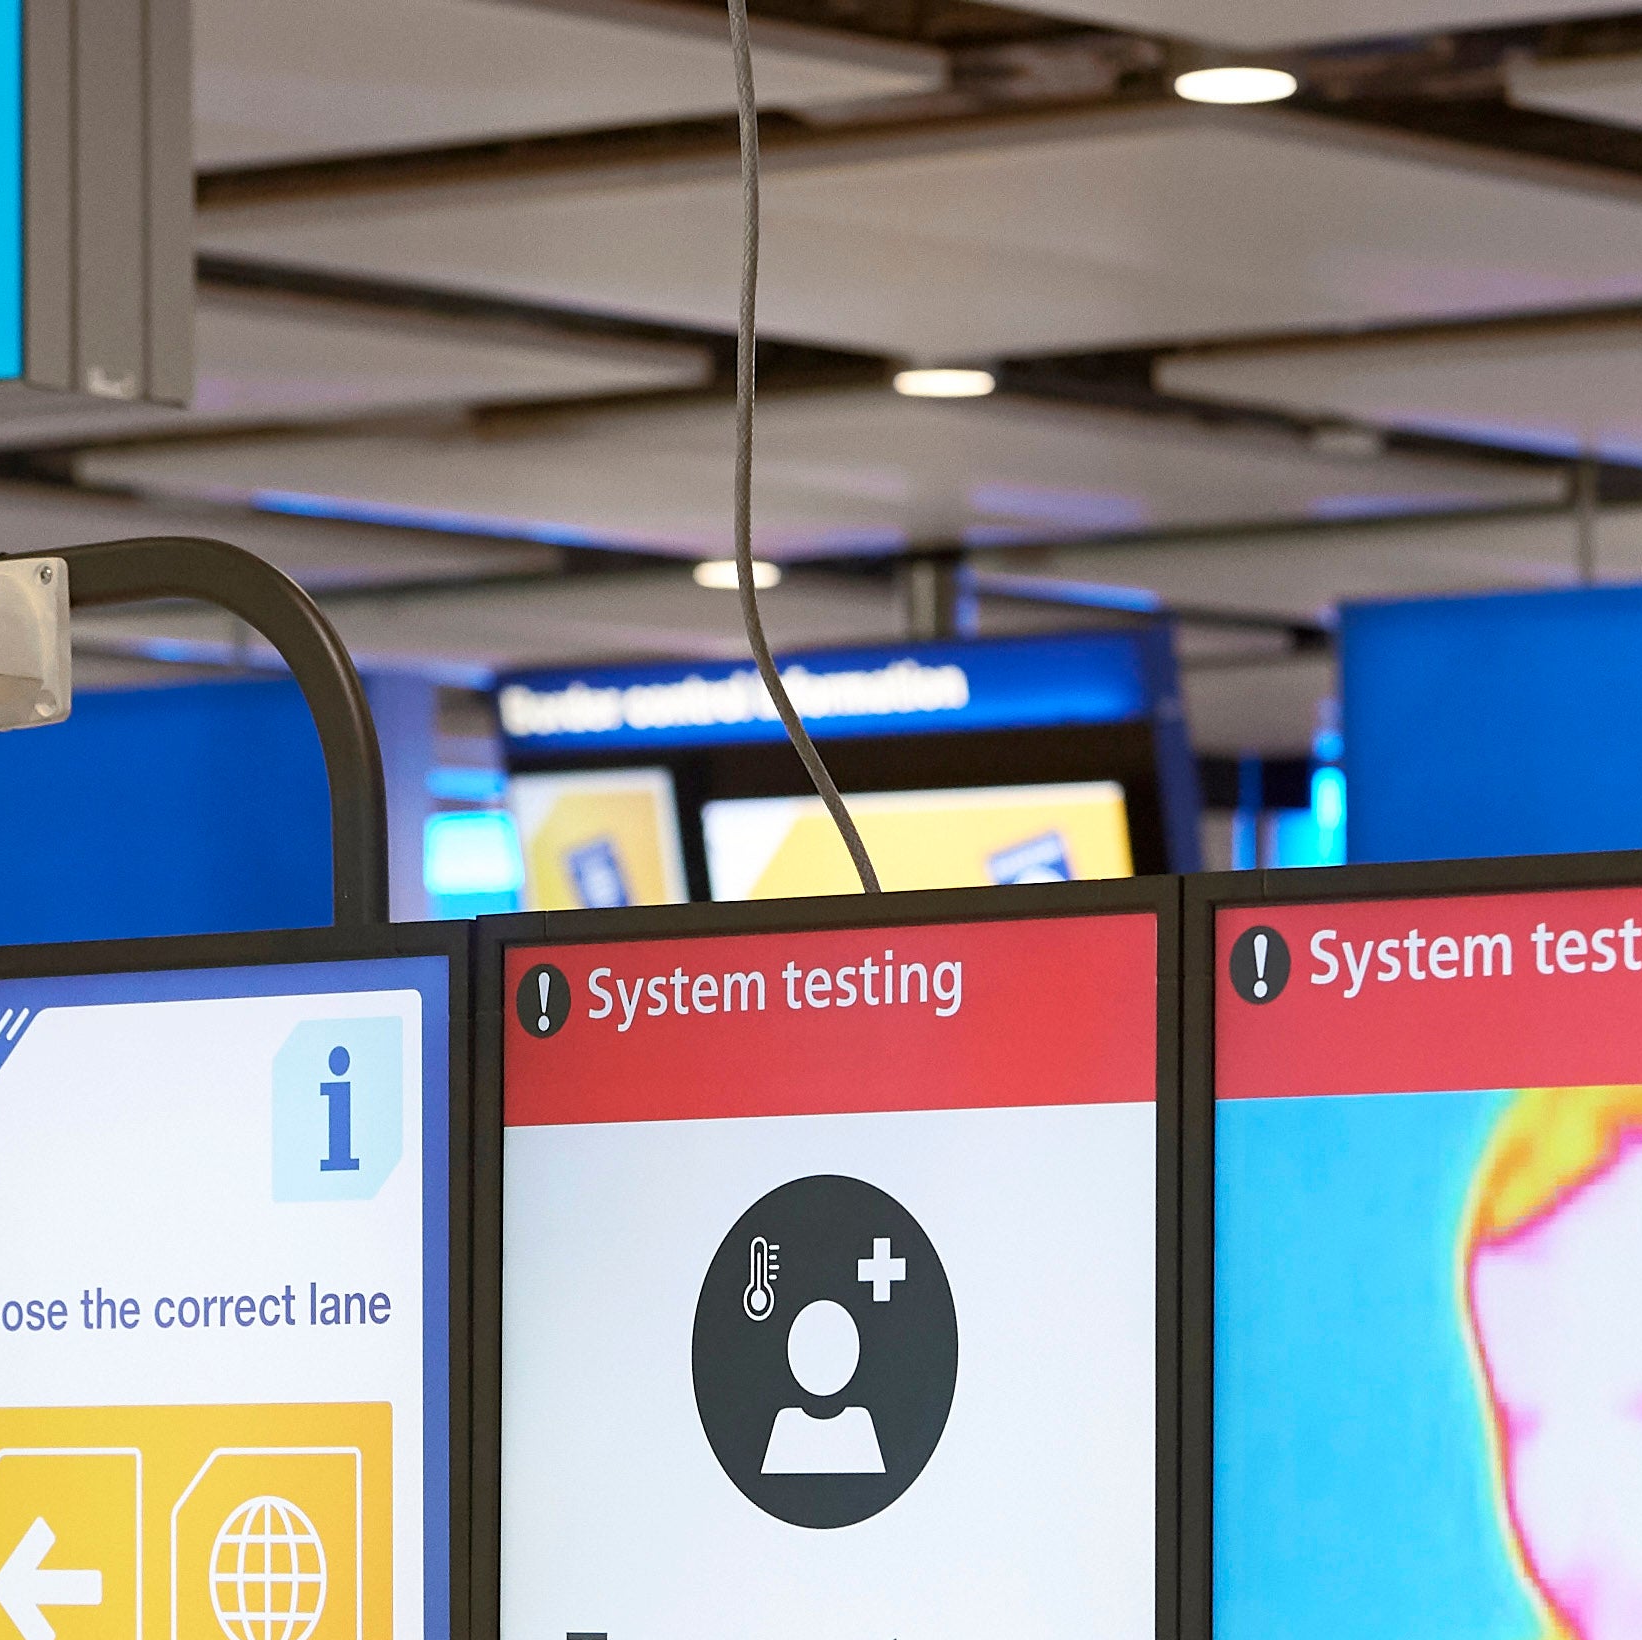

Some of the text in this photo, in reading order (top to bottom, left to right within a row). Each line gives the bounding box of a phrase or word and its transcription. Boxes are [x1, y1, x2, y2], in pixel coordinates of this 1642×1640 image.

[588, 950, 961, 1032] System testing
[1311, 929, 1512, 998] System
[81, 1287, 141, 1329] the
[154, 1285, 296, 1328] correct
[310, 1282, 392, 1325] lane
